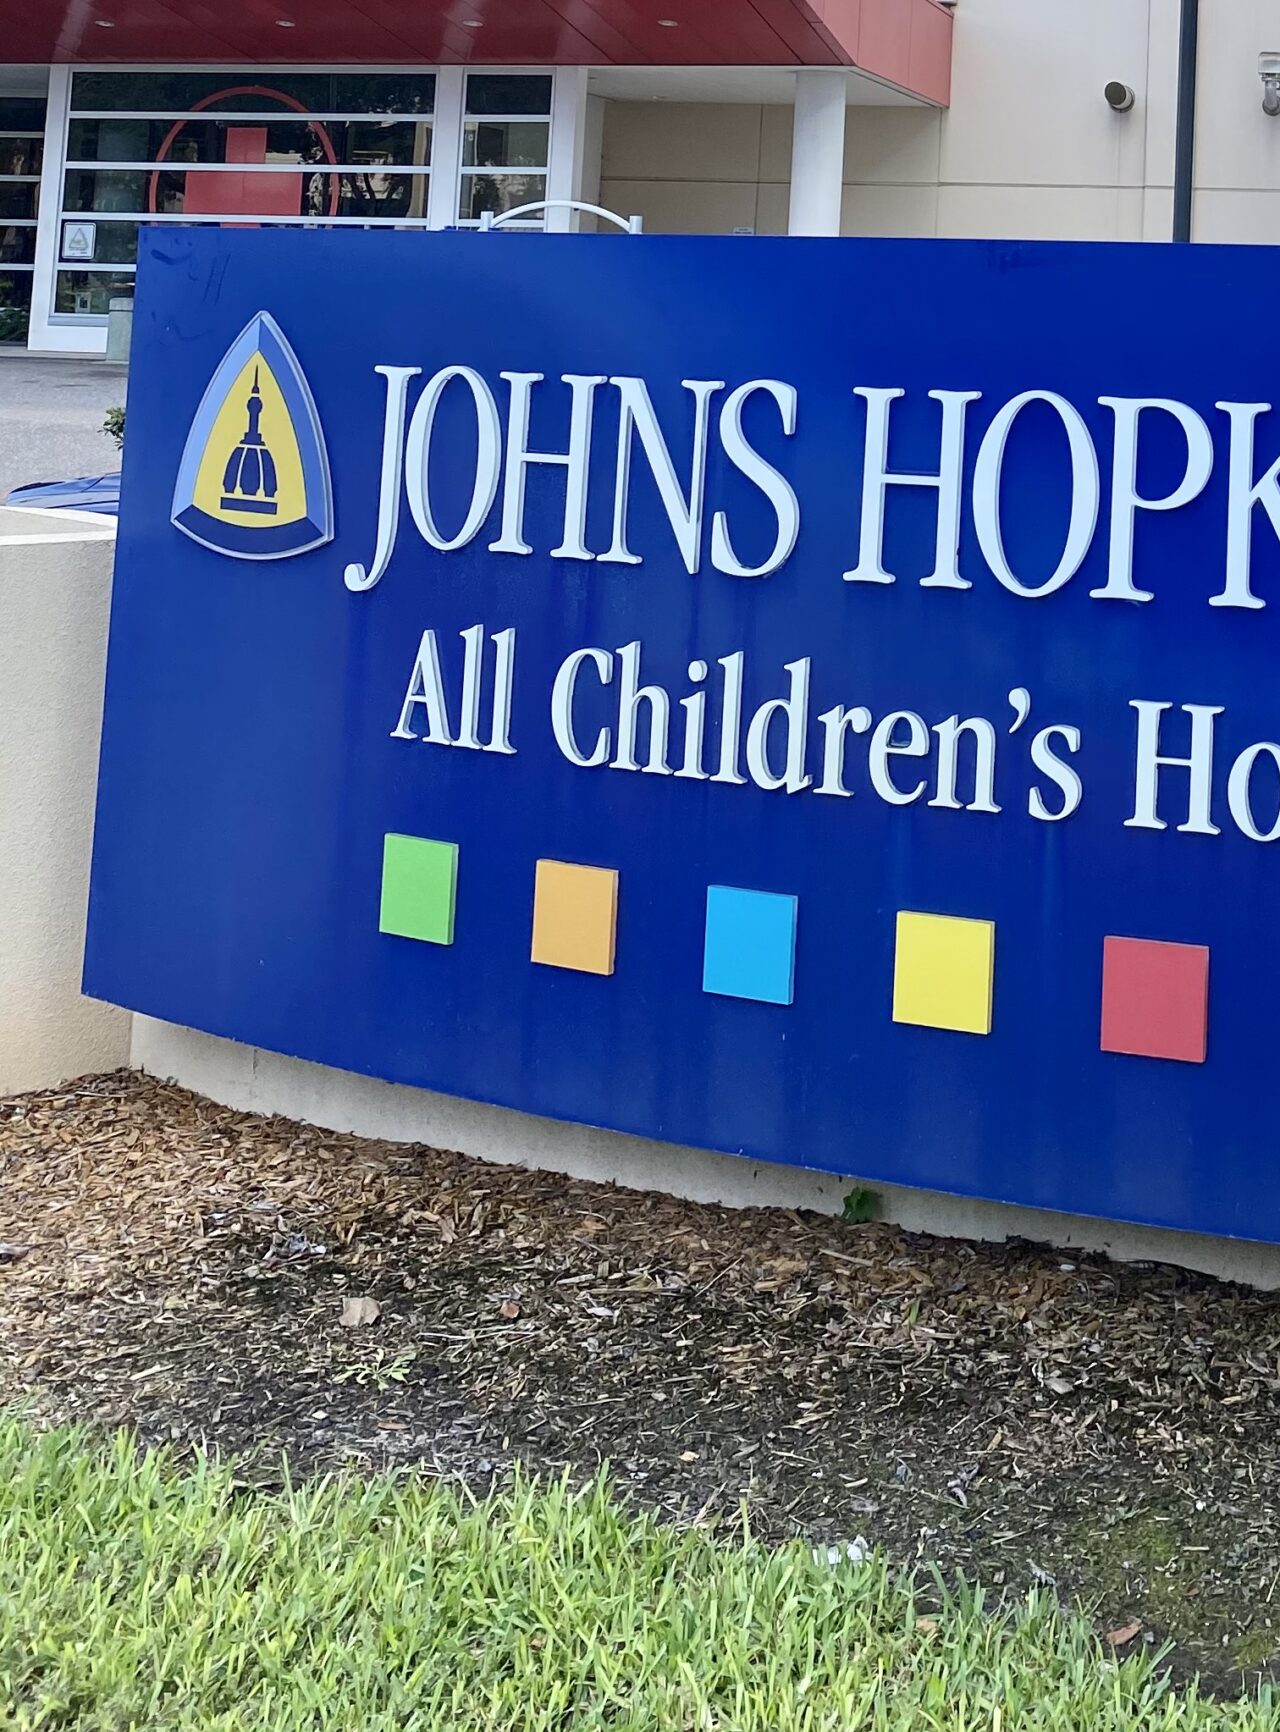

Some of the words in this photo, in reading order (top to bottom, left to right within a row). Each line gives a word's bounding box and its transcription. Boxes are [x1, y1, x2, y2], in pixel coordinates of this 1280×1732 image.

[344, 365, 800, 592] JOHNS
[389, 623, 517, 755] All
[551, 639, 1084, 822] Children's
